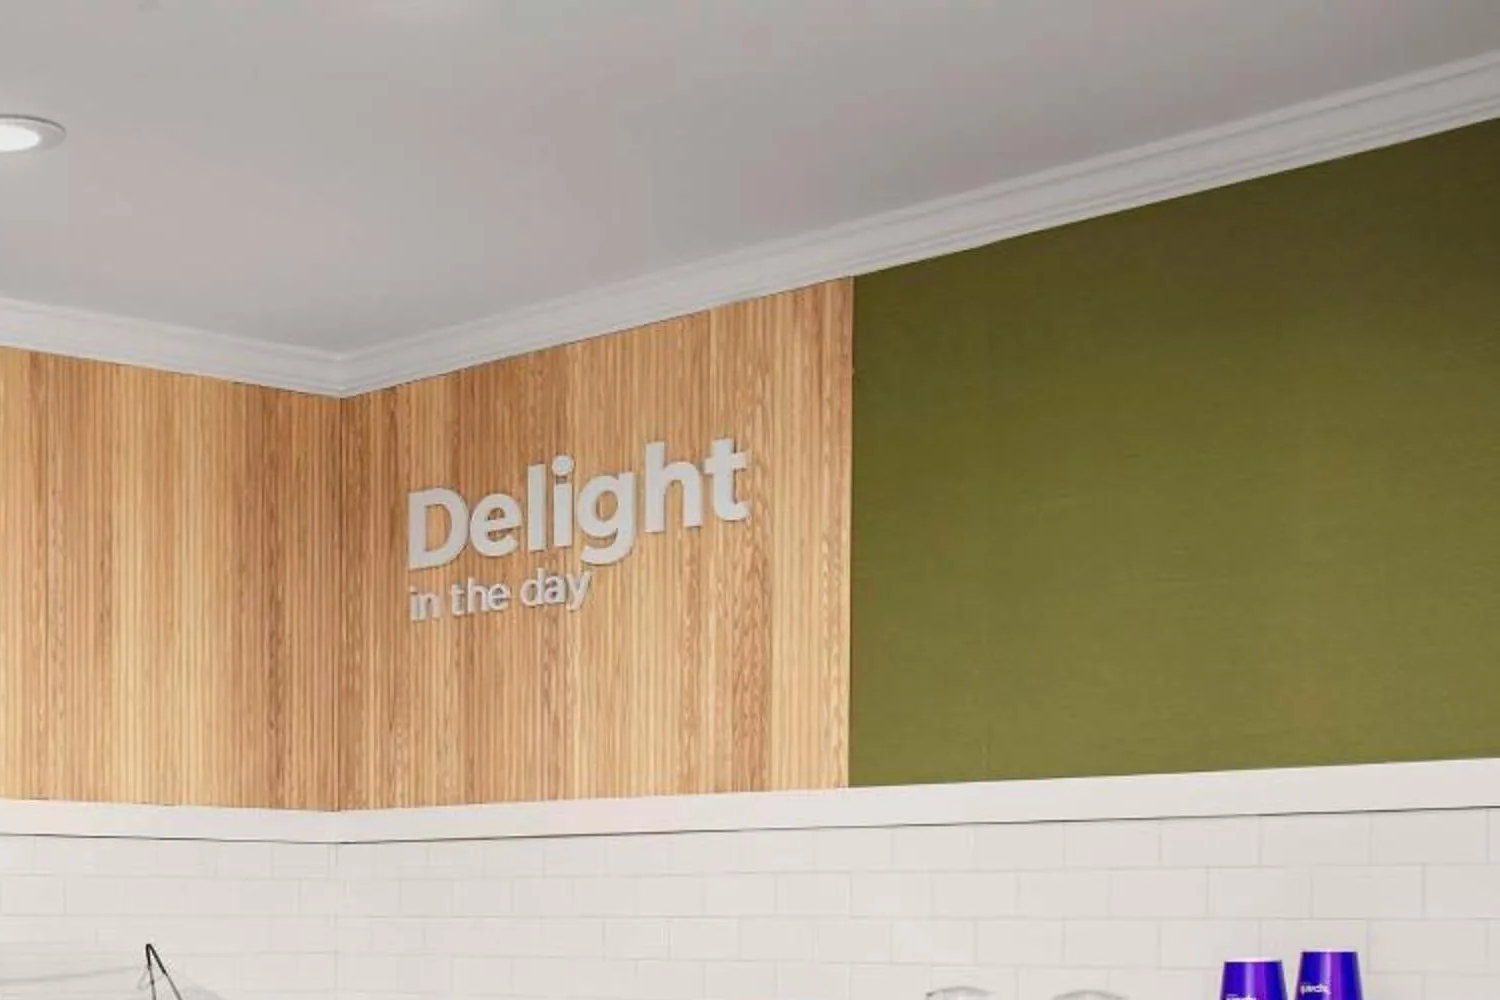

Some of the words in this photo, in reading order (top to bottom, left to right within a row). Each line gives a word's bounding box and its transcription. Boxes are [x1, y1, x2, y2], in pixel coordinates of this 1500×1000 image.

[407, 437, 750, 571] Delight
[410, 586, 440, 621] in
[450, 577, 511, 617] the
[519, 567, 592, 612] day
